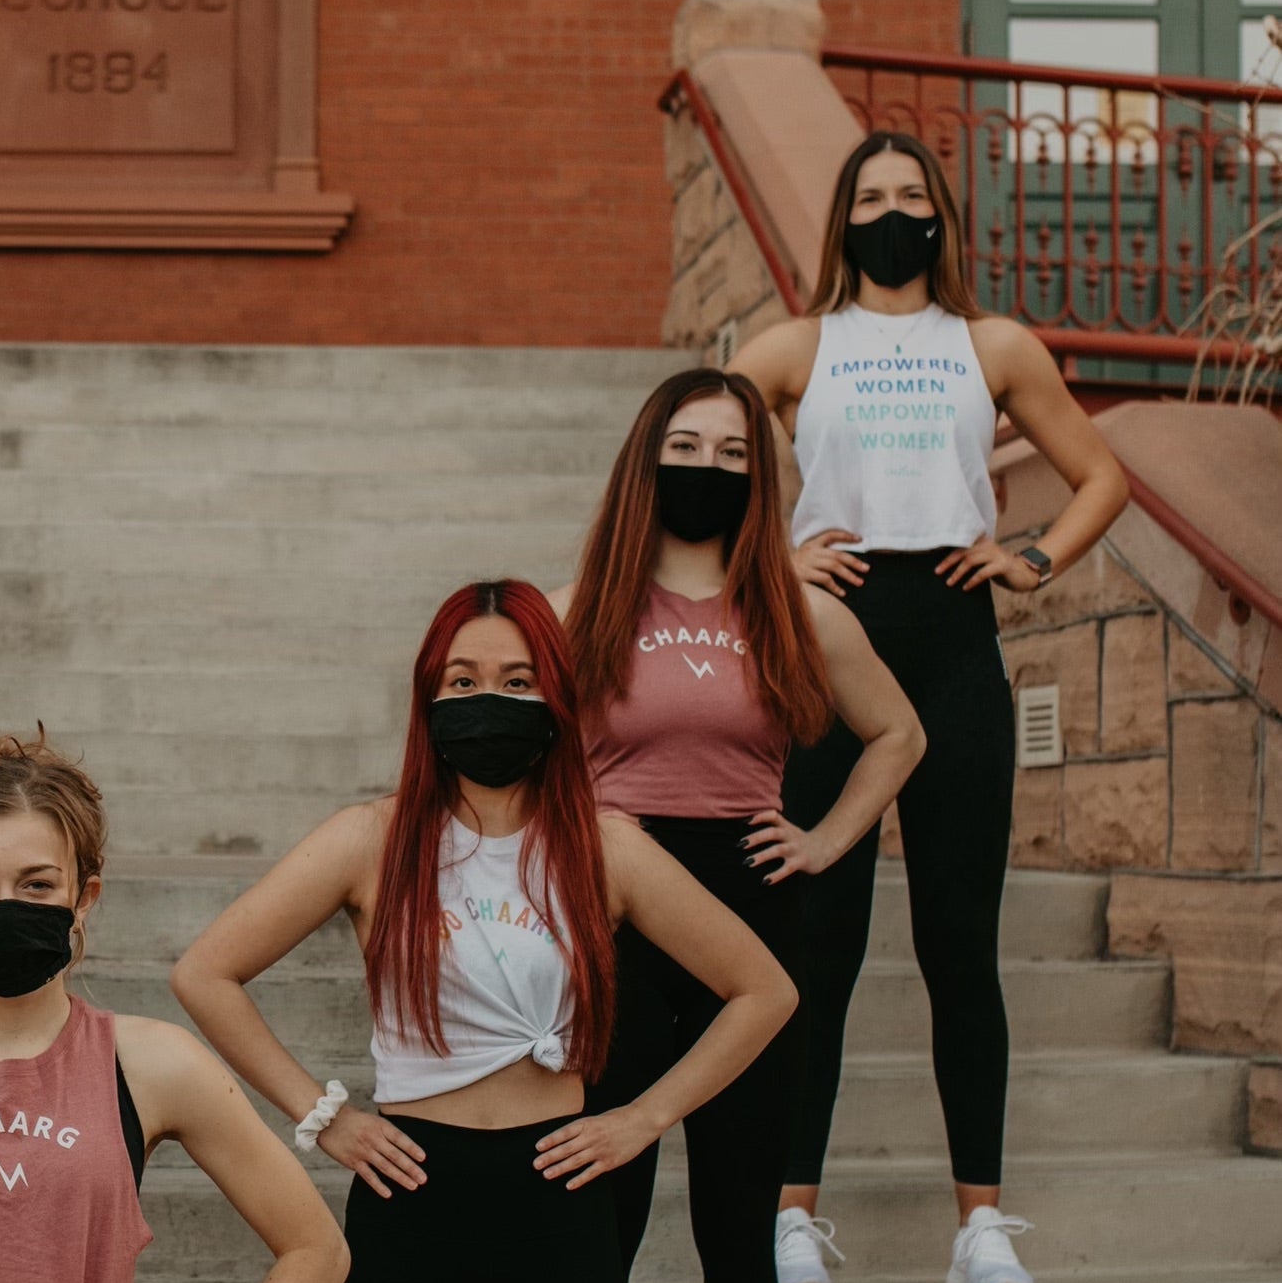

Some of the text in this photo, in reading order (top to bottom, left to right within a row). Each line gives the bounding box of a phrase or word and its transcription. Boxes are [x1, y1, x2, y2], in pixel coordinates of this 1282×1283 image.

[47, 50, 167, 95] 1884
[831, 358, 967, 378] EMPOWERED
[855, 379, 946, 394] WOMEN
[845, 404, 957, 422] EMPOWER
[859, 432, 946, 450] WOMEN
[638, 627, 750, 655] CHAARG
